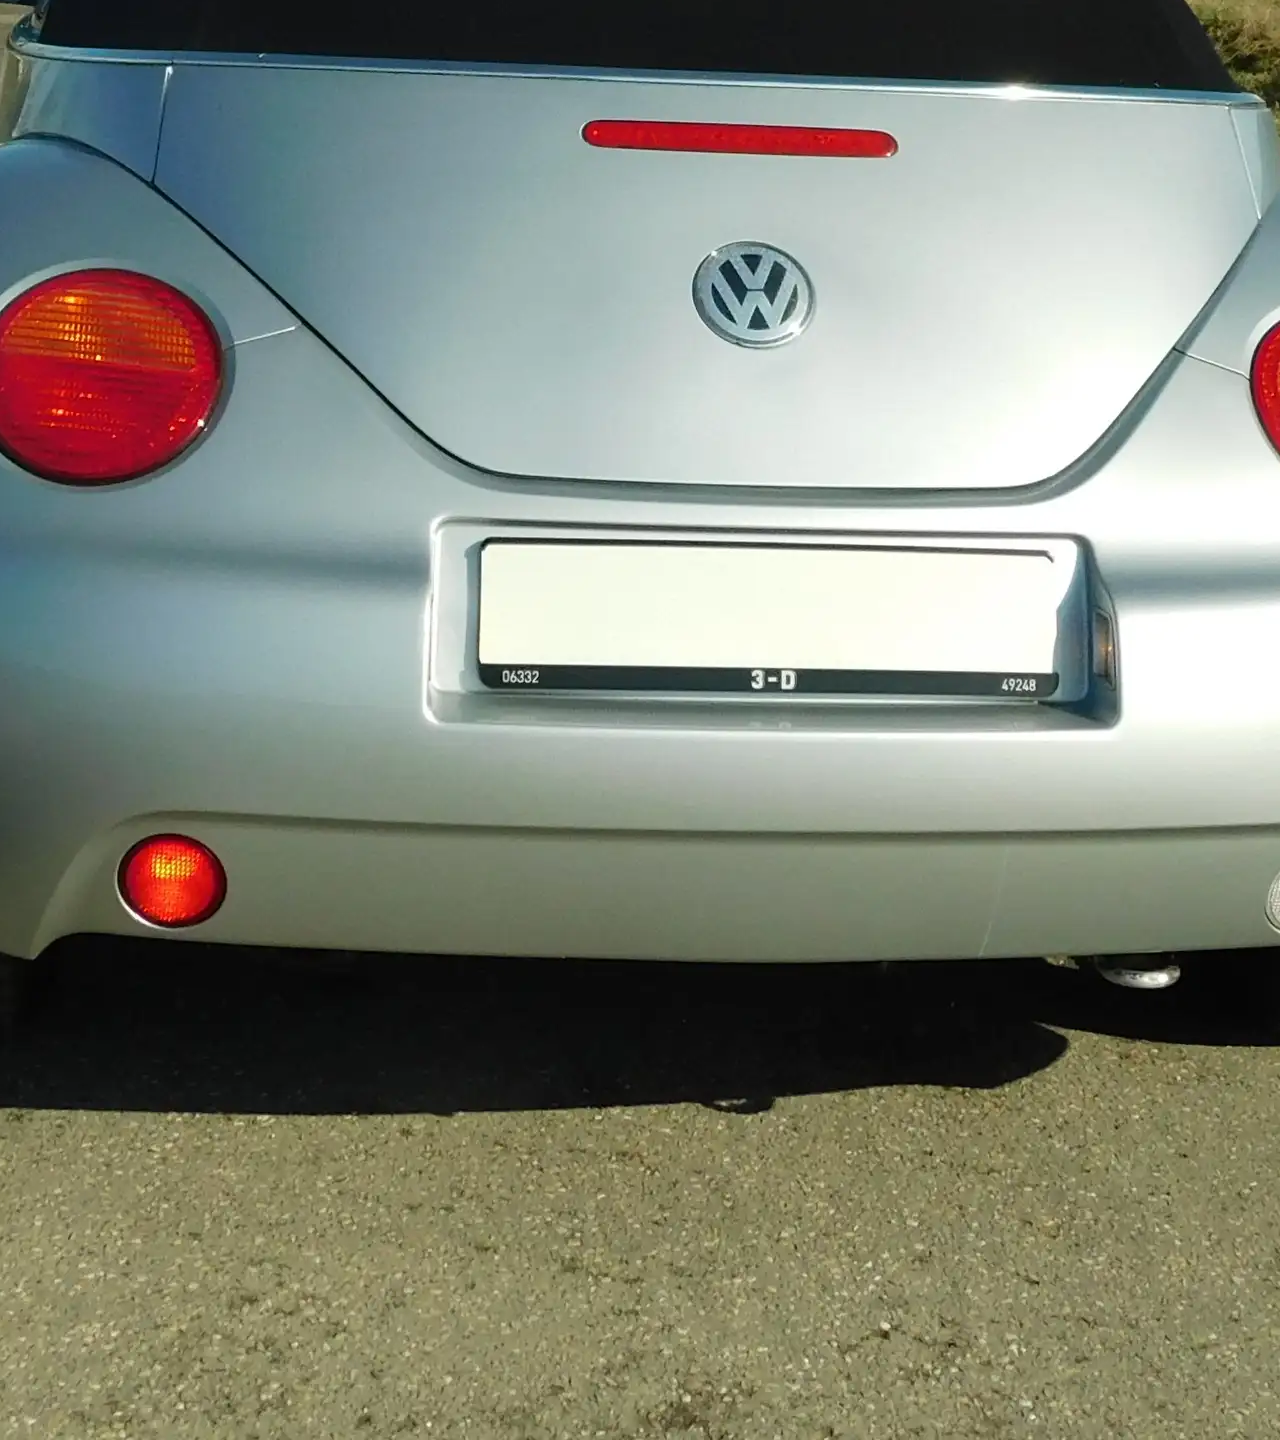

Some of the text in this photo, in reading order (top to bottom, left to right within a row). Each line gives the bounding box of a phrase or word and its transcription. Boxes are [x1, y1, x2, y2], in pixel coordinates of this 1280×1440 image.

[706, 248, 803, 338] VW
[502, 669, 539, 684] 06332
[1001, 678, 1037, 692] 49248
